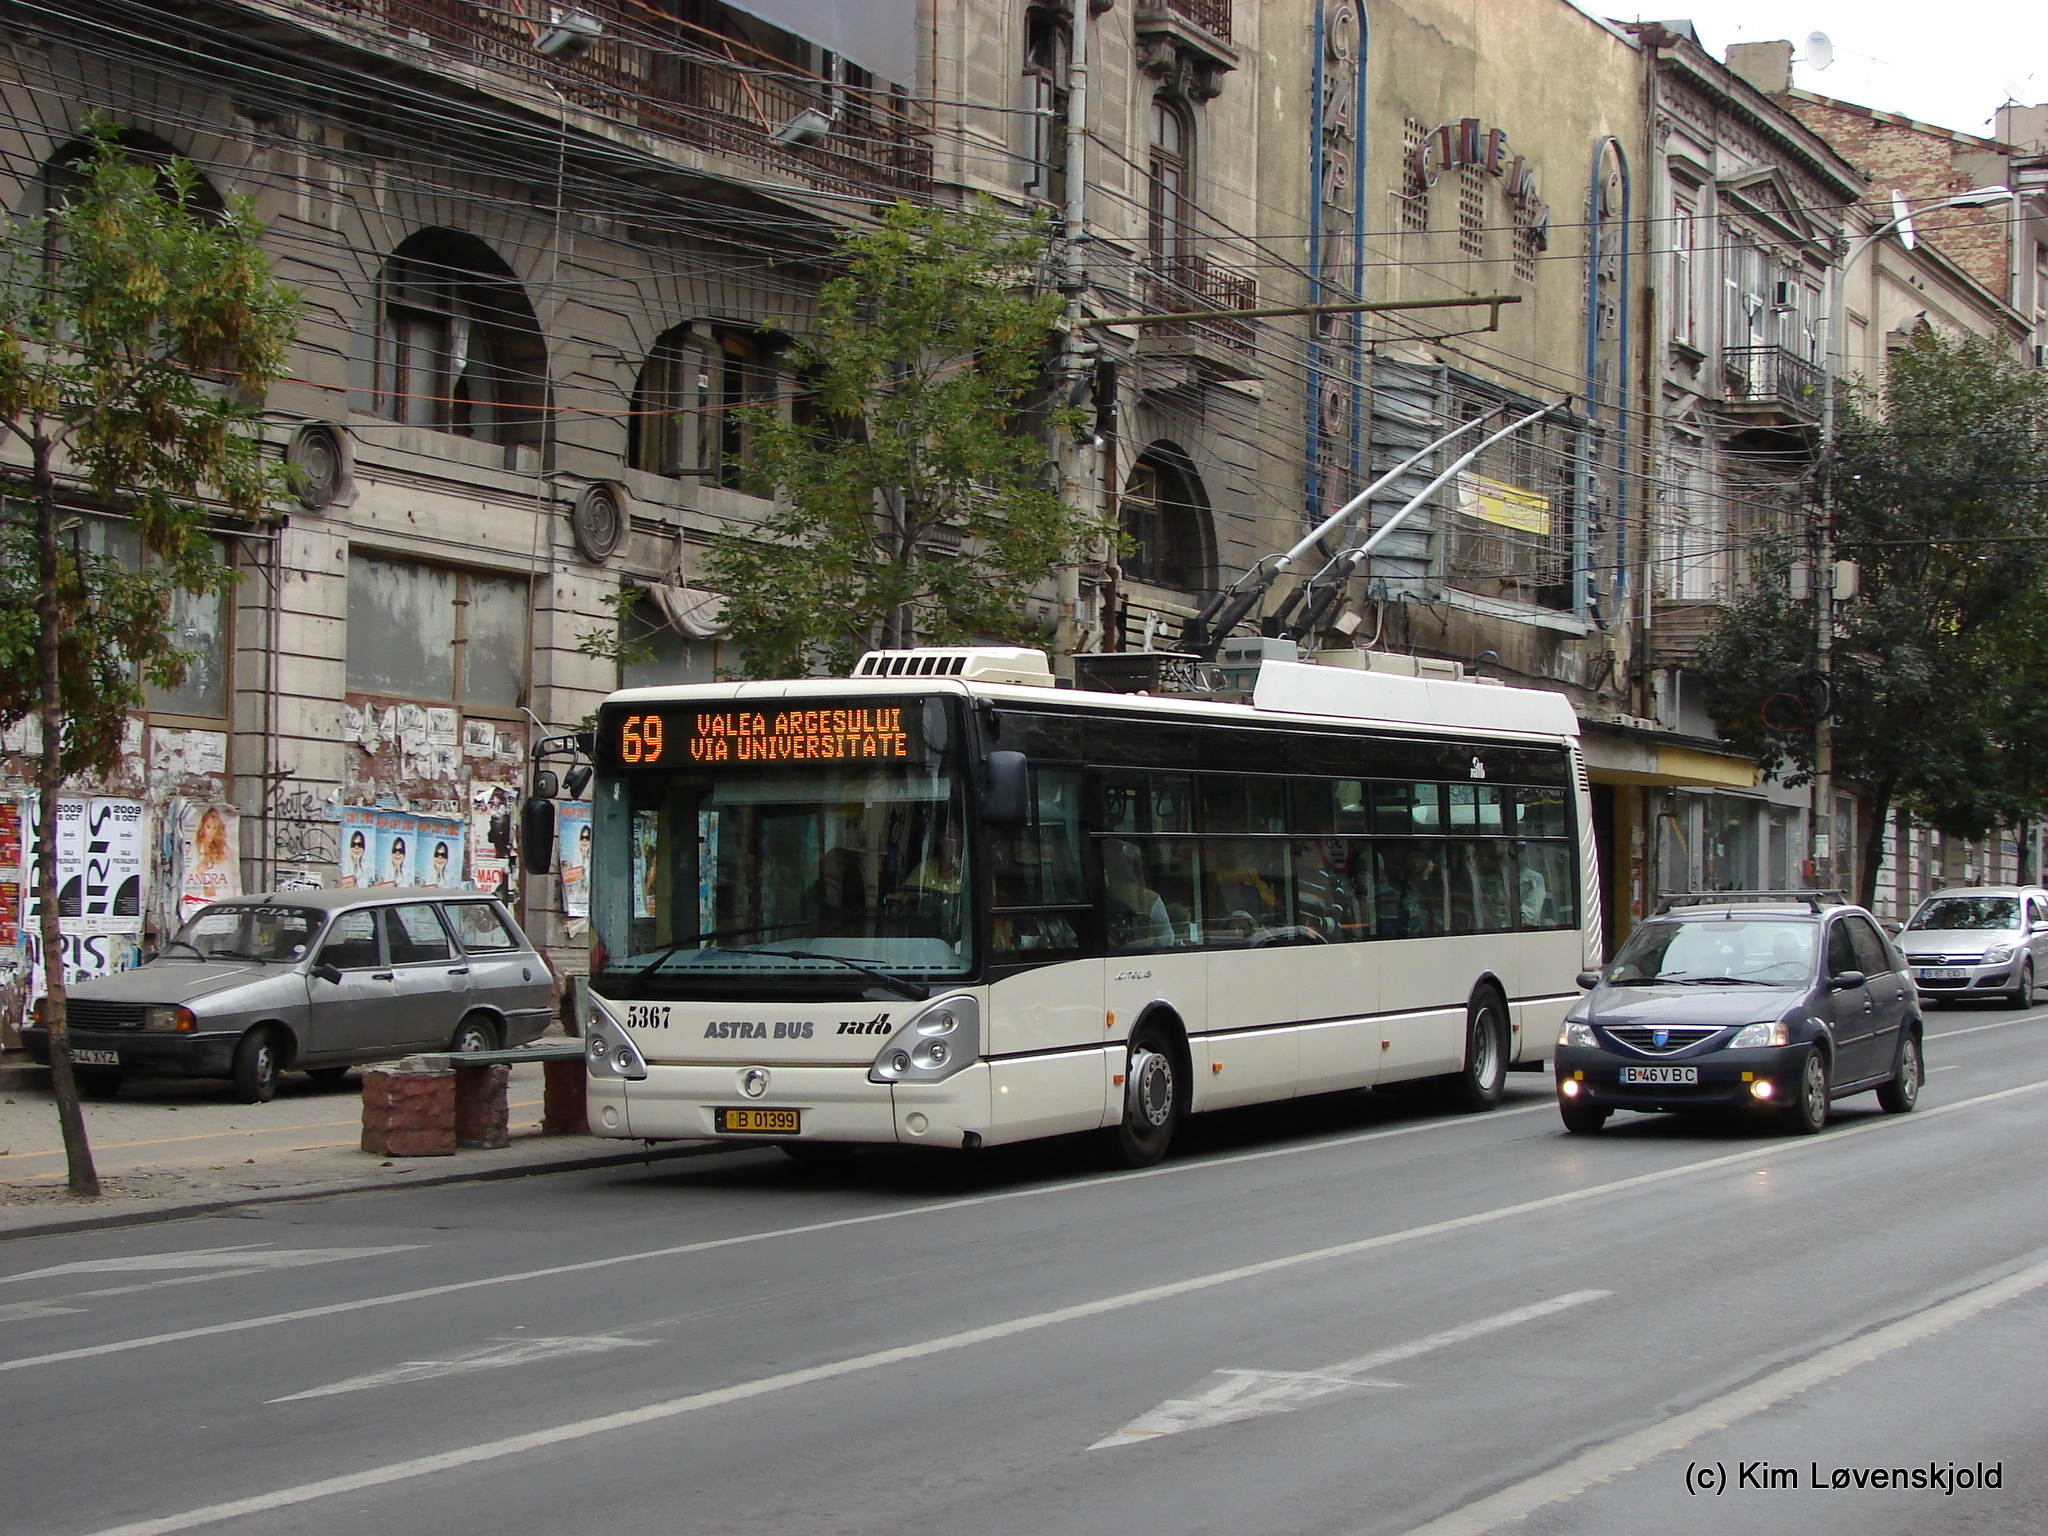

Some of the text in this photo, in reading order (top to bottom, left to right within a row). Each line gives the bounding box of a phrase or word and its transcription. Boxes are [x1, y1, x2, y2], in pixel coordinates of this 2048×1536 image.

[1413, 117, 1550, 252] CINEMA
[697, 708, 901, 737] VALEA ARGESULUI
[622, 715, 663, 763] 69
[690, 732, 907, 761] VIA UNIVERSITATE
[57, 804, 83, 813] 2009
[113, 805, 141, 814] 2009
[87, 801, 111, 915] IRIS
[627, 1006, 671, 1029] 5367
[836, 1013, 892, 1035] ratb
[704, 1022, 814, 1039] ASTRA BUS
[1627, 1068, 1637, 1081] B
[738, 1112, 794, 1128] B 01399
